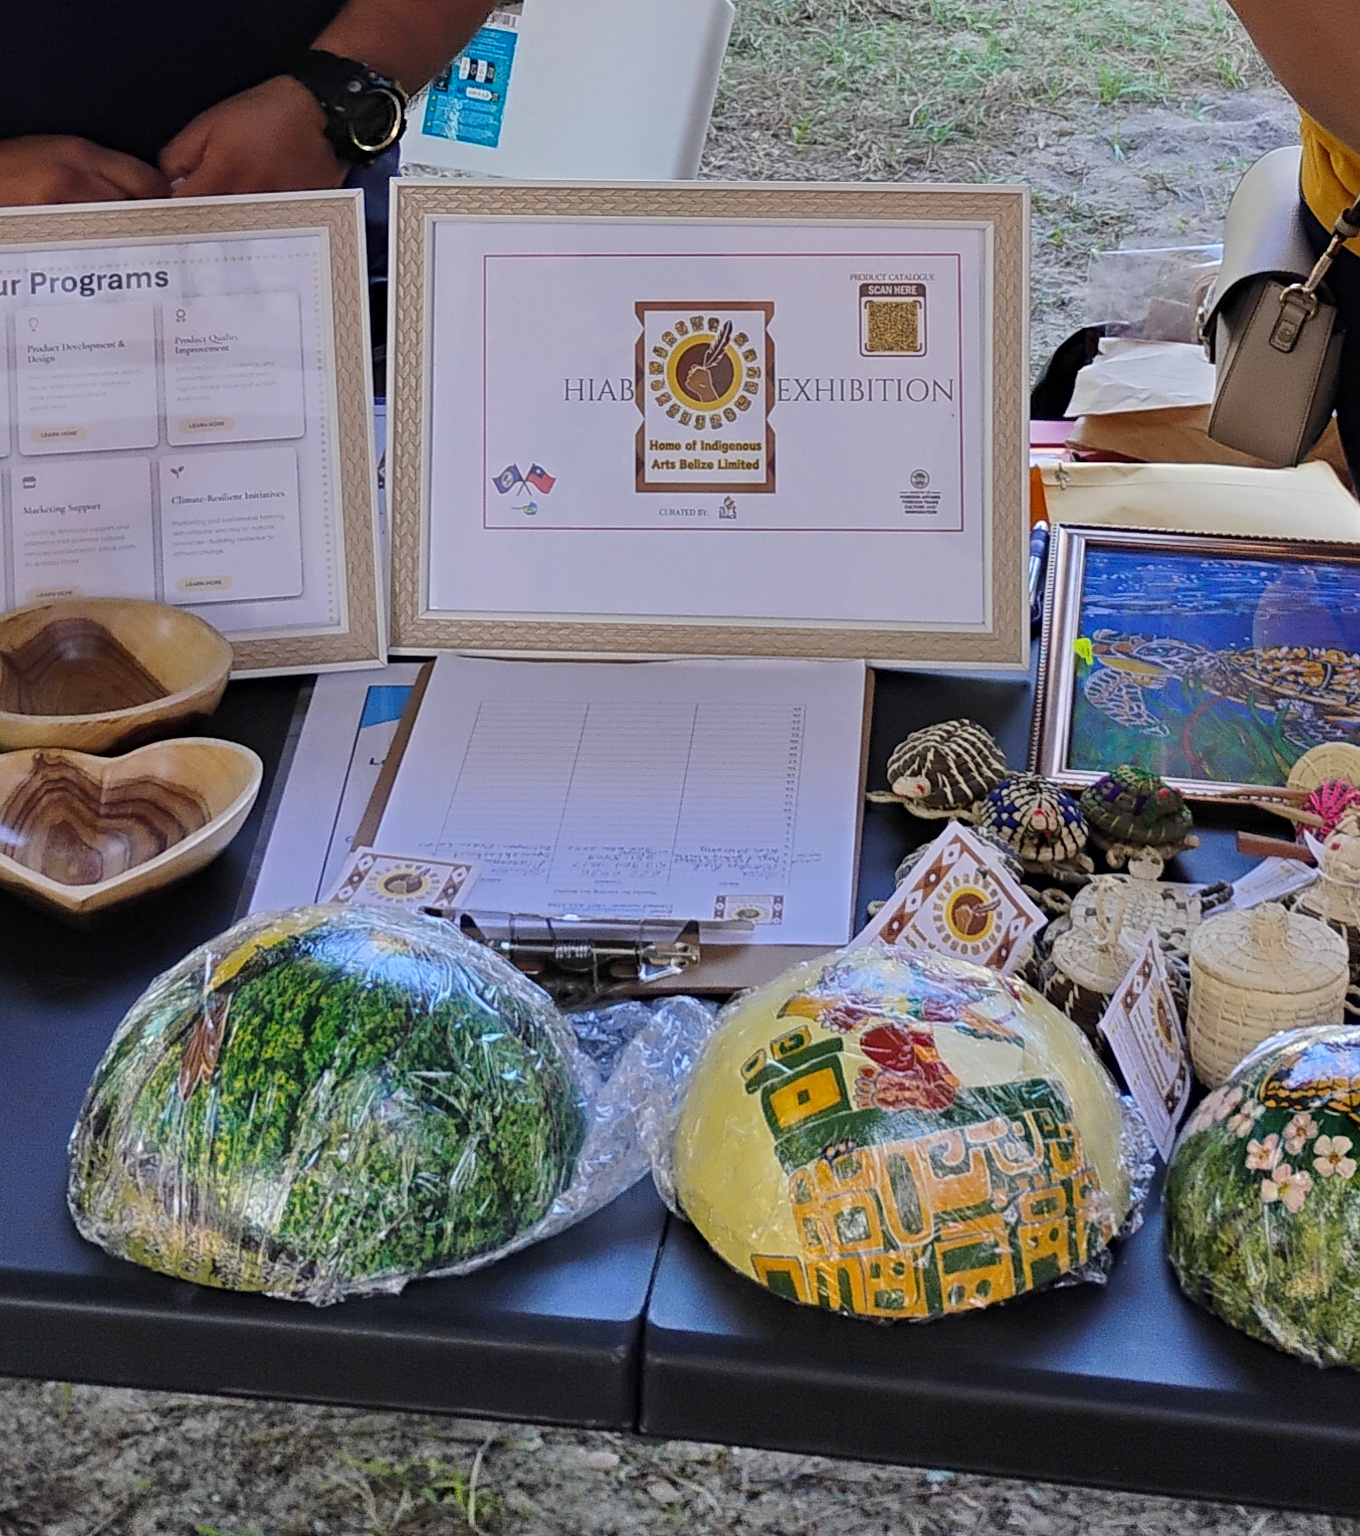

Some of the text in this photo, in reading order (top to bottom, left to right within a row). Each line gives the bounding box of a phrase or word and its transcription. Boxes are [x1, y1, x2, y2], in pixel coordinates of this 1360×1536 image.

[30, 269, 170, 297] Programs
[888, 273, 935, 281] CATALOGUE
[868, 285, 918, 294] SCAN HERE
[175, 333, 238, 345] Product Quality
[27, 340, 126, 353] Product Development &
[175, 345, 229, 356] Improvement
[27, 355, 56, 364] Design
[563, 377, 955, 403] HIAB EXHIBITION
[649, 440, 762, 453] Home of Indigenous
[651, 459, 759, 470] Arts Belize Limited
[171, 491, 285, 505] Climate-Resilient Initiatives
[23, 503, 101, 515] Marketing Support
